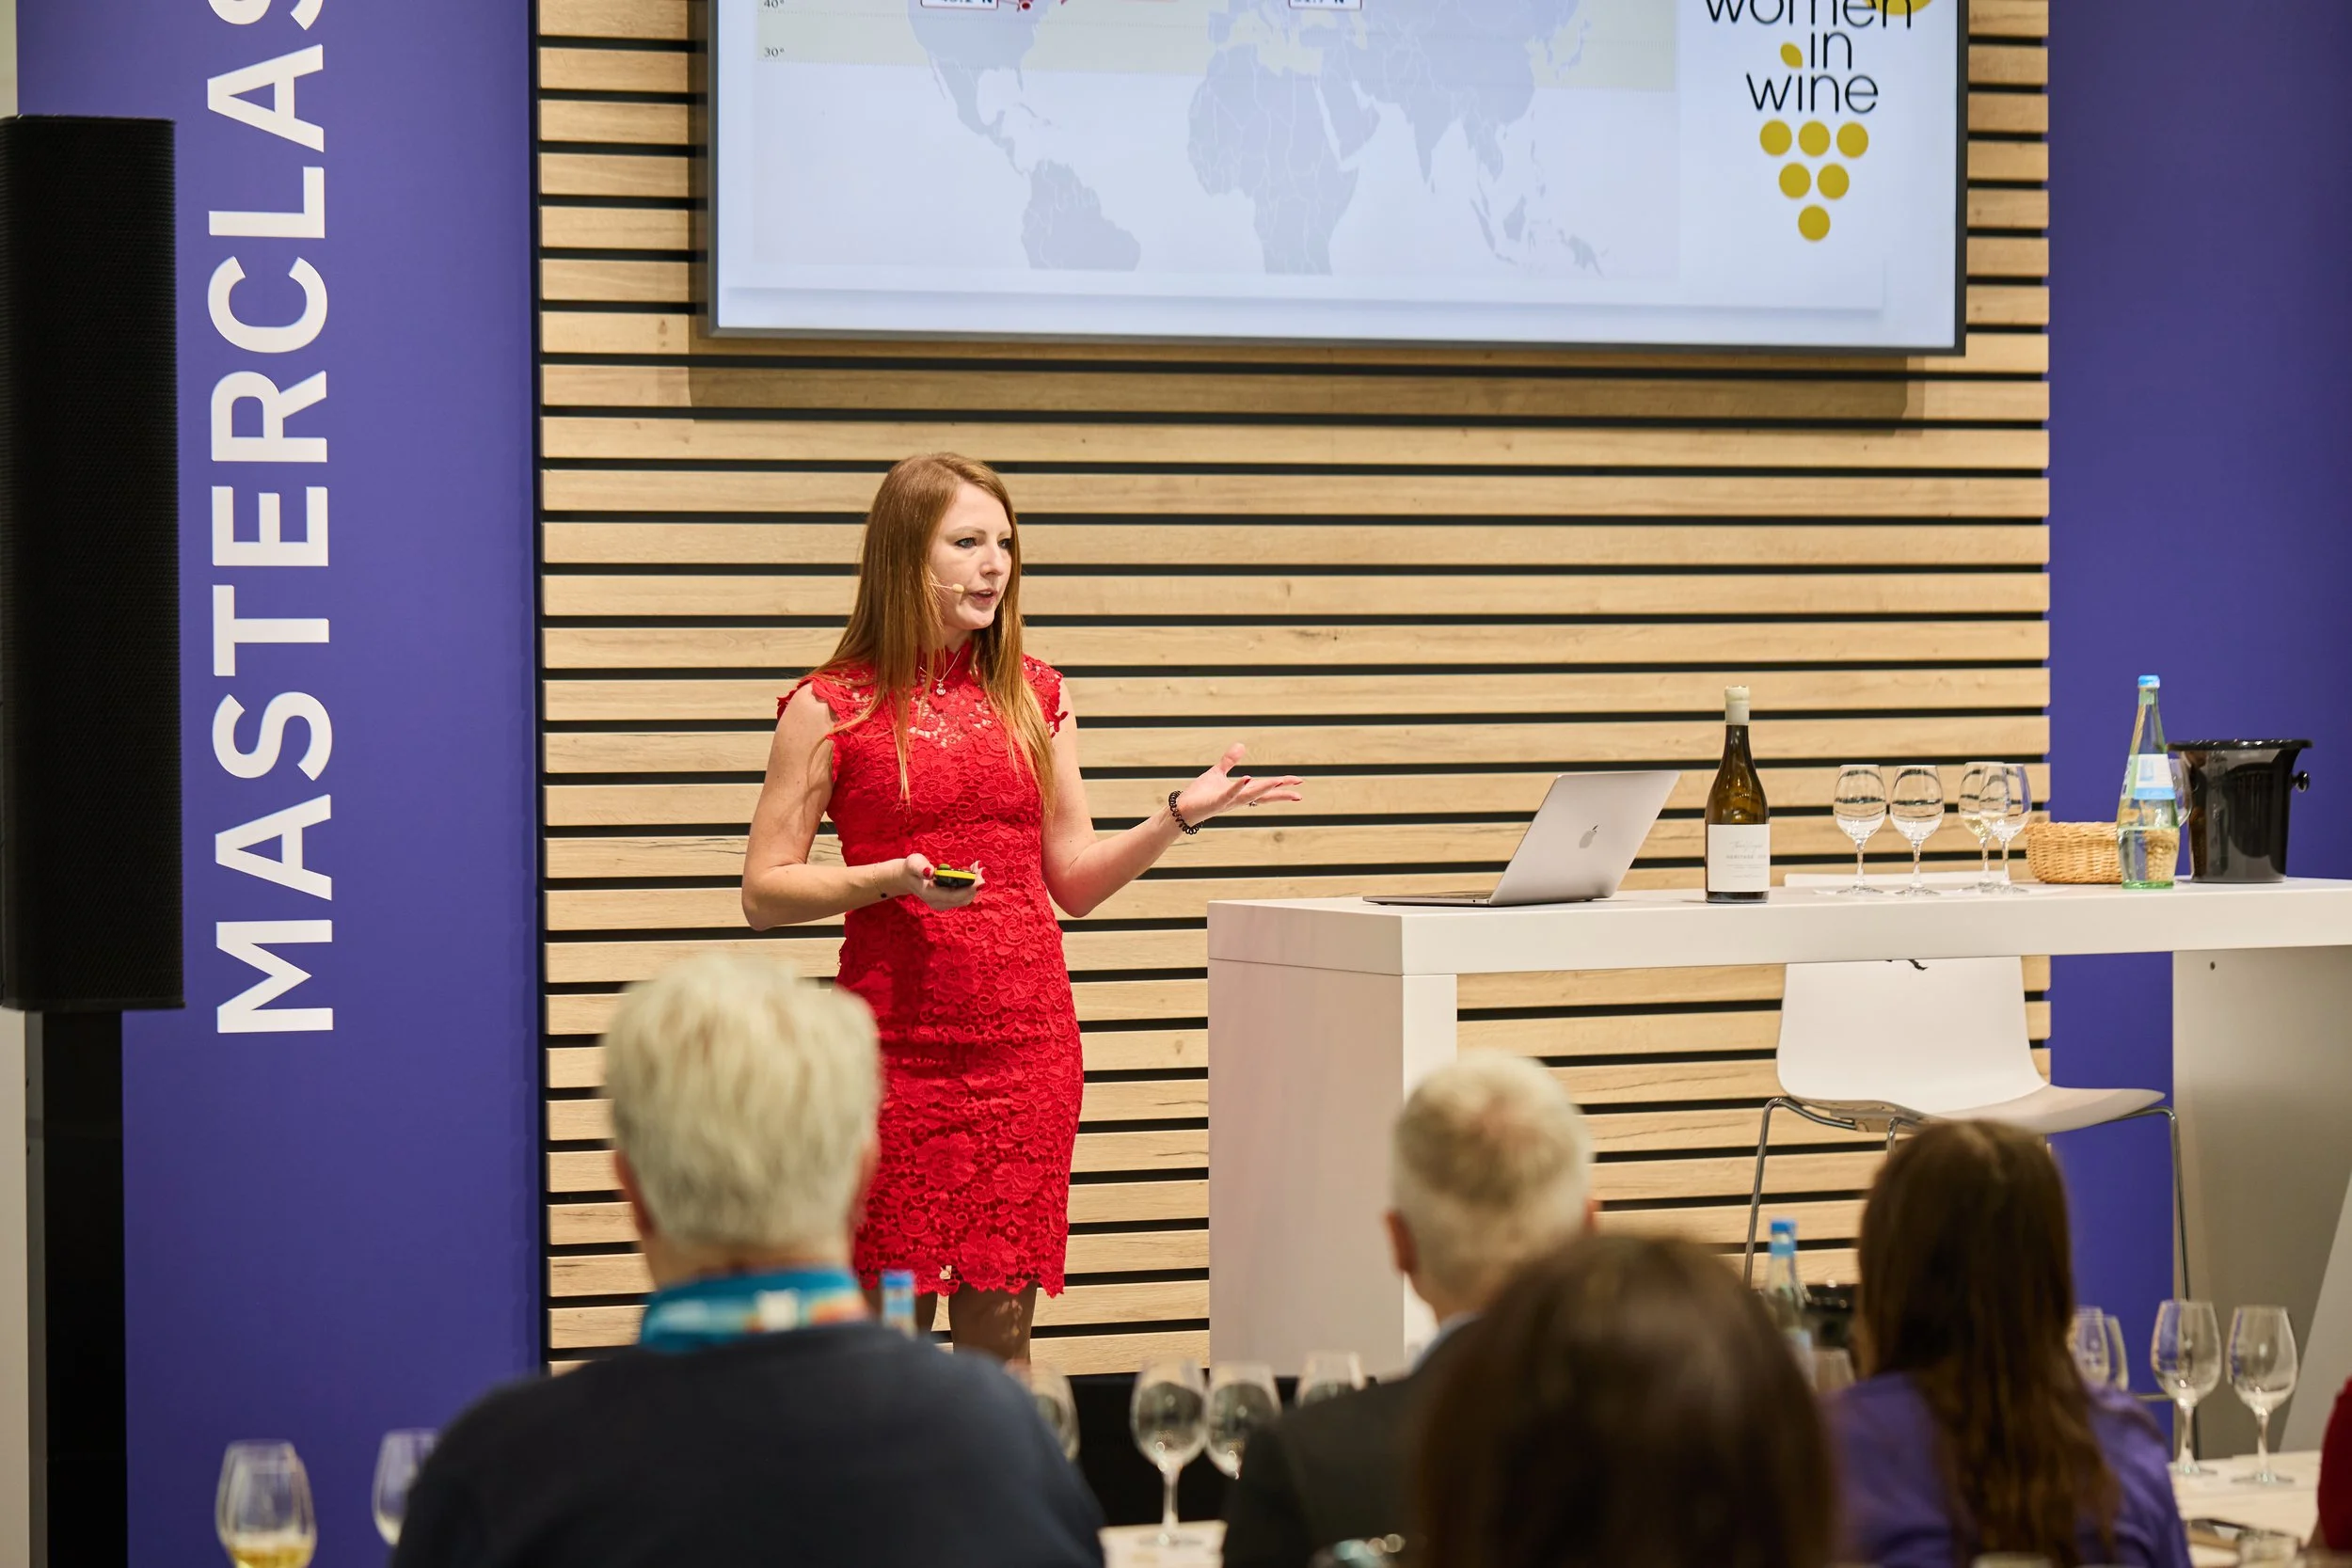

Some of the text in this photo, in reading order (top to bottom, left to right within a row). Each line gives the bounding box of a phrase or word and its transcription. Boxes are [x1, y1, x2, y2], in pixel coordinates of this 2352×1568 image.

[1706, 0, 1912, 28] women
[763, 46, 786, 58] 30°
[1810, 31, 1852, 71] in
[1745, 72, 1879, 114] wine
